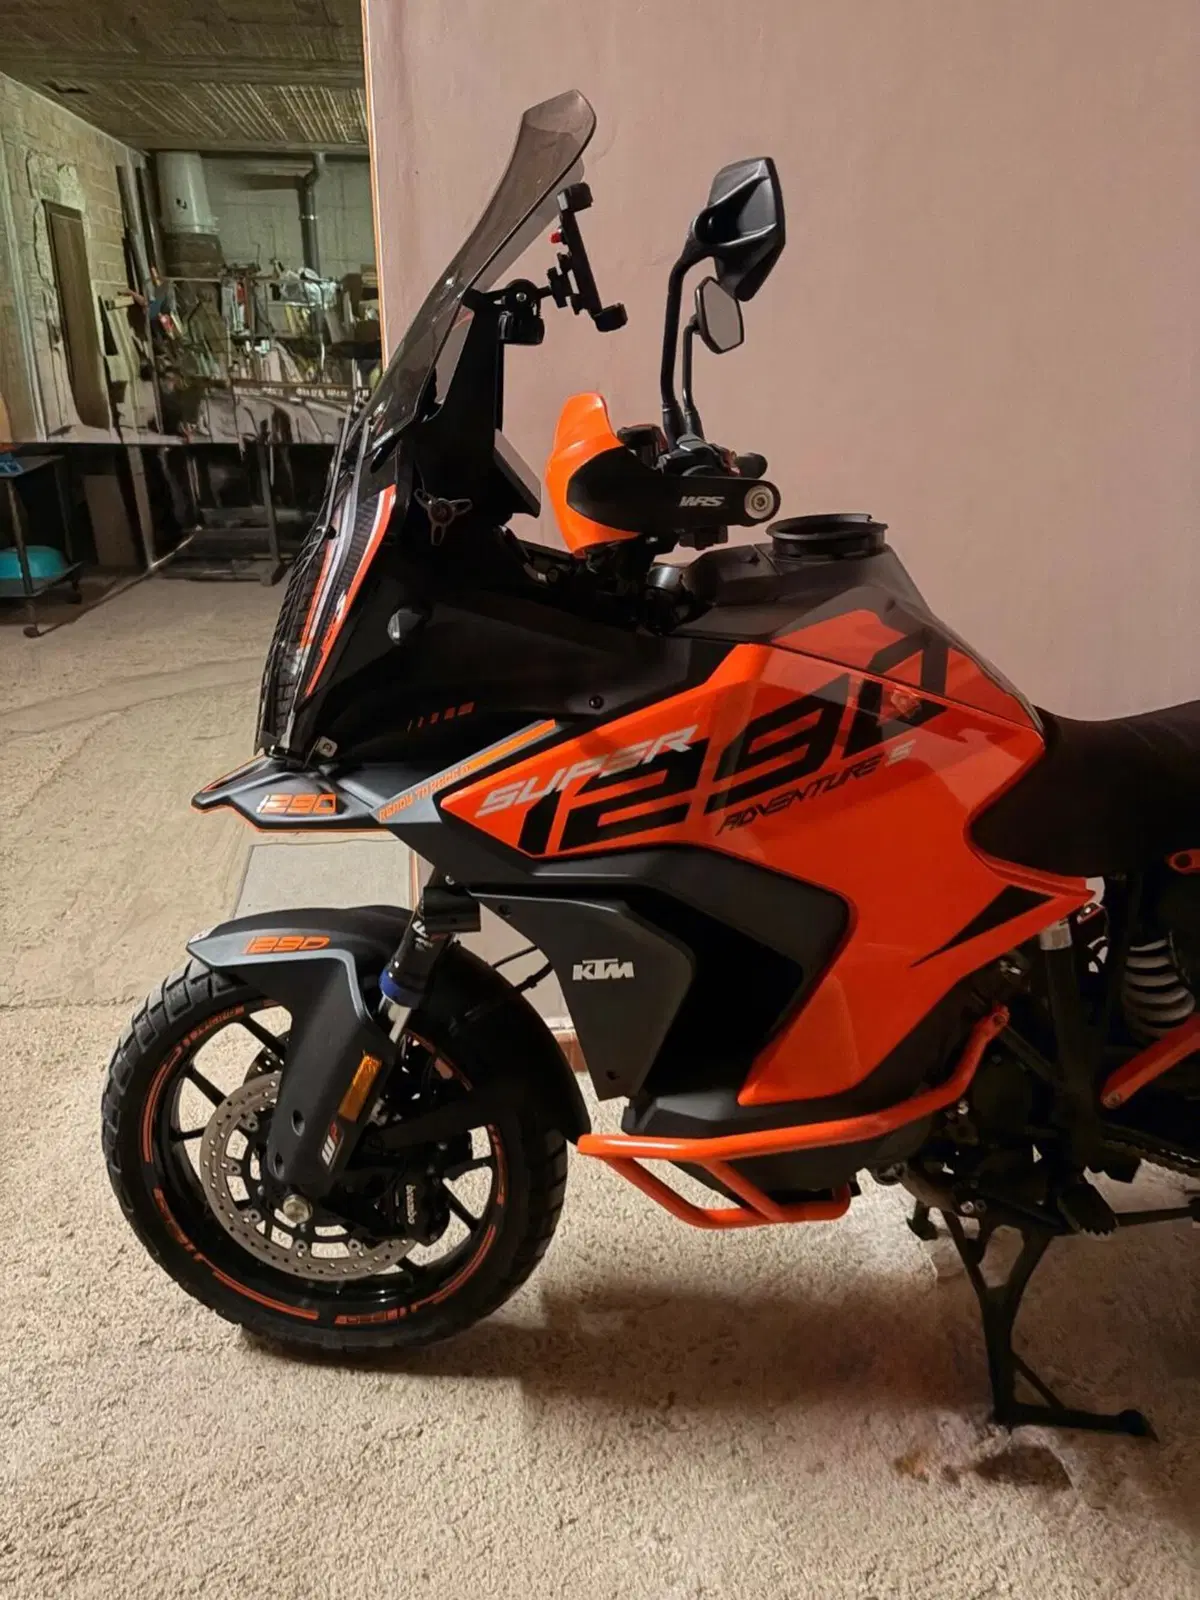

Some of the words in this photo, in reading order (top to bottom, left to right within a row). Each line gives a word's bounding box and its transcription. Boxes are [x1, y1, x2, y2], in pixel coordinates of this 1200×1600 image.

[679, 496, 726, 507] WRS
[474, 724, 698, 819] SUPER
[714, 751, 885, 837] ADVENTURE
[886, 739, 918, 768] S
[256, 793, 338, 815] 1290
[243, 935, 331, 955] 1290
[572, 958, 635, 981] KTM
[405, 1184, 417, 1225] brembo
